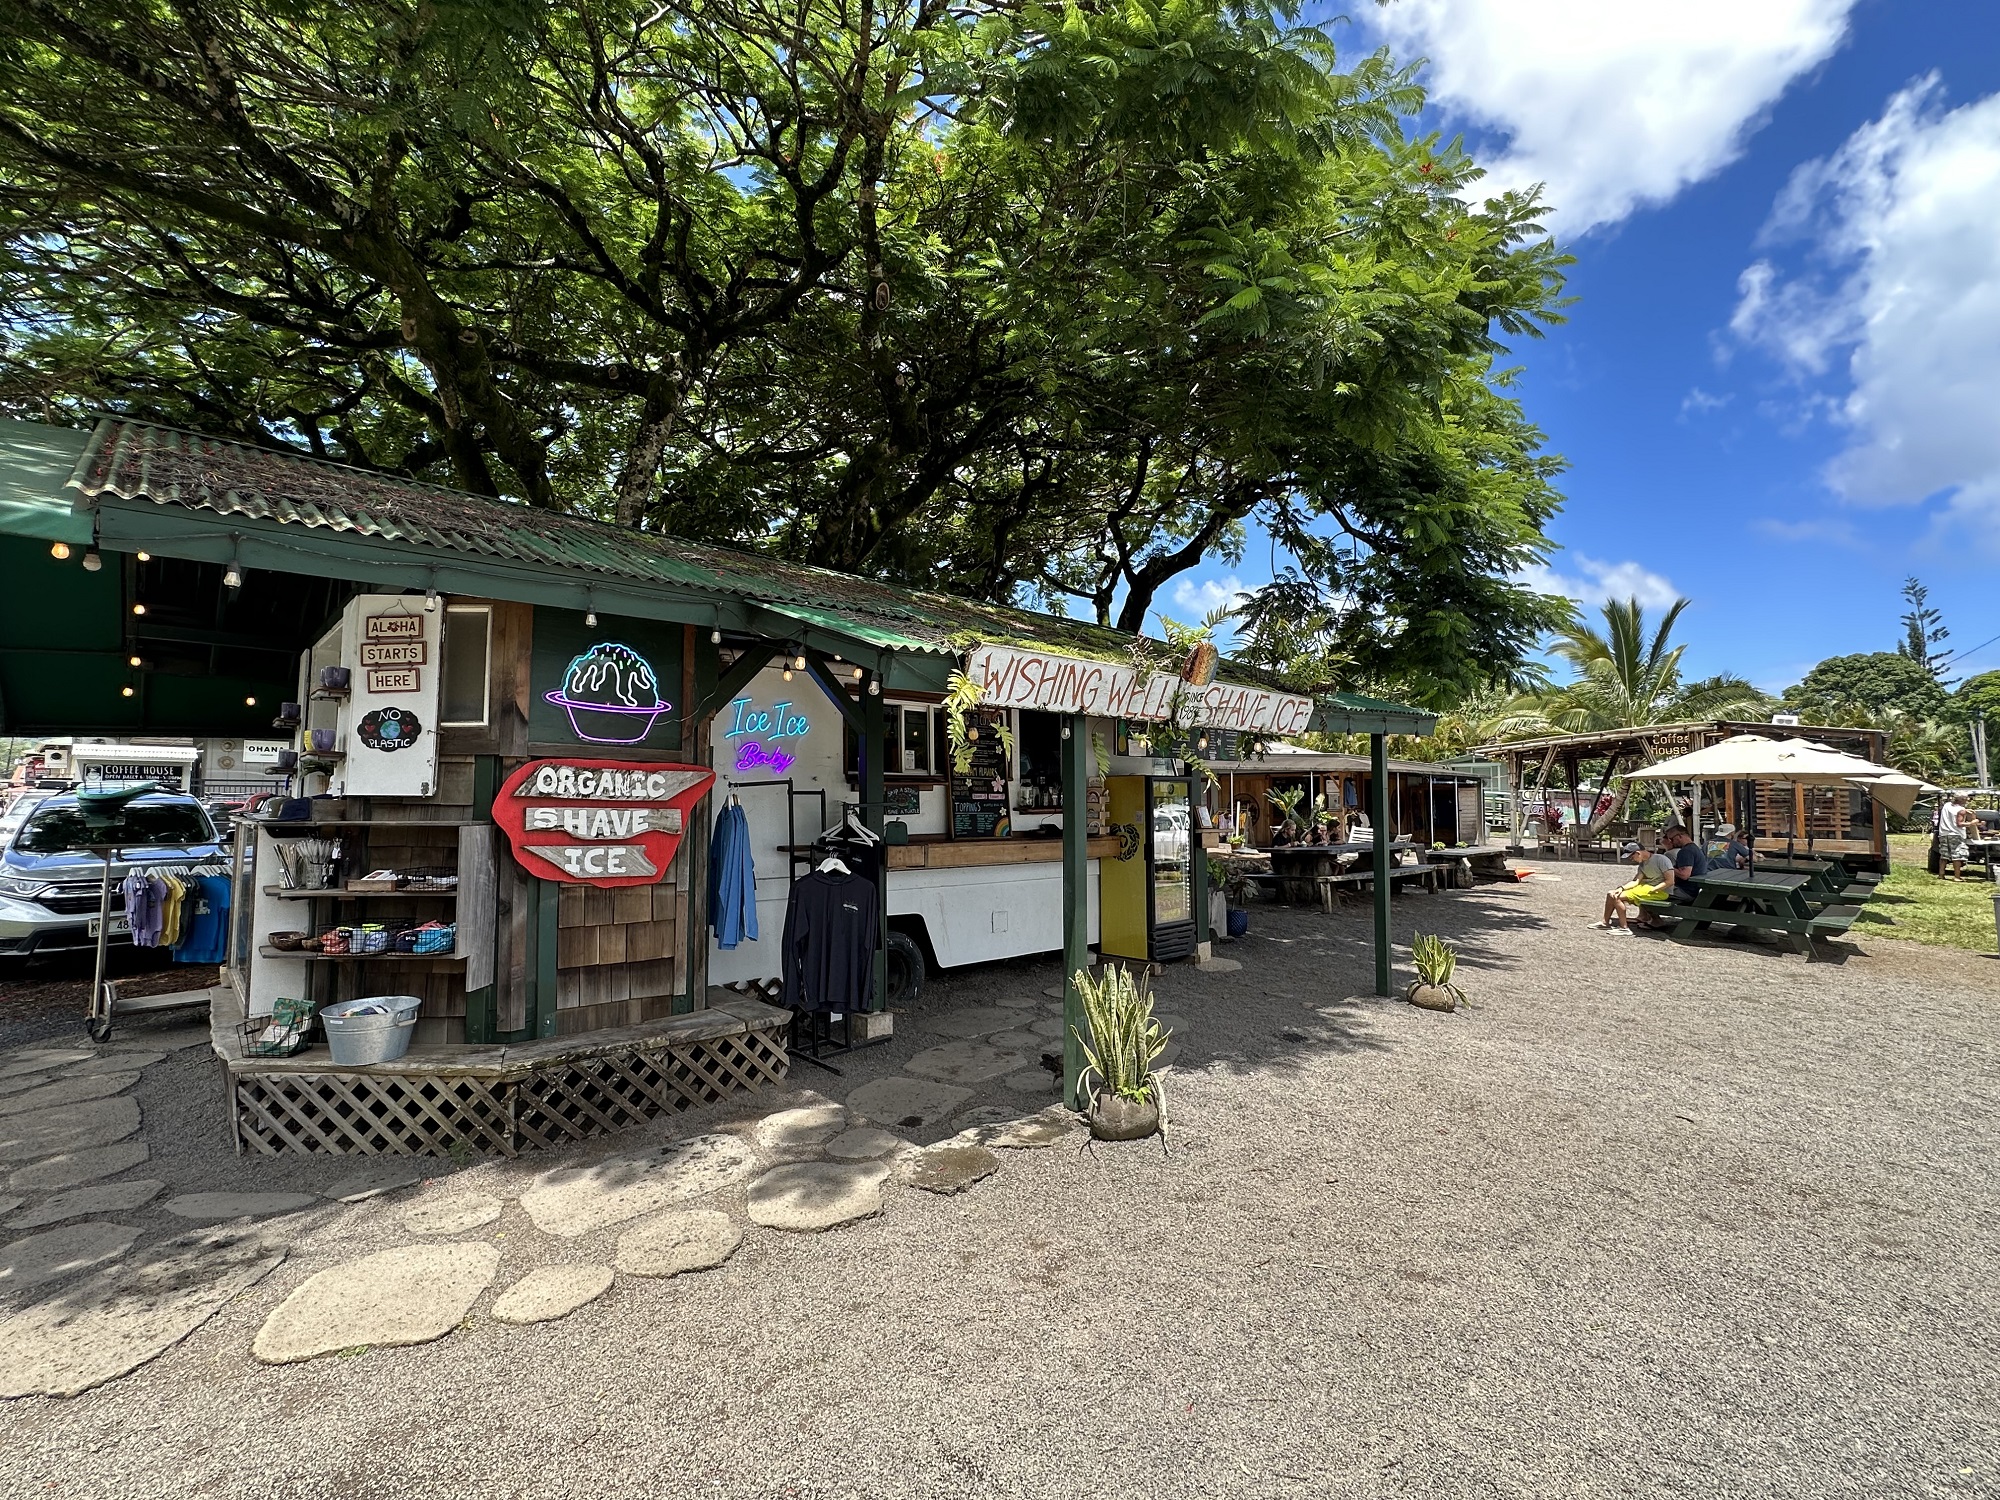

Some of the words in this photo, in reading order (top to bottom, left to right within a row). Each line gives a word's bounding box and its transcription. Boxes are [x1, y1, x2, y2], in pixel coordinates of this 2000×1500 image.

[368, 648, 418, 660] STARTS
[376, 675, 411, 687] HERE
[982, 652, 1103, 712] WISHING
[1106, 671, 1170, 719] WELL
[1186, 691, 1205, 703] SINCE
[379, 710, 401, 721] NO
[1204, 686, 1270, 729] SHAVE
[1270, 697, 1309, 734] ICE
[724, 698, 772, 739] Ice
[767, 702, 810, 741] Ice
[368, 738, 411, 748] PLASTIC
[1652, 733, 1689, 745] Coffee
[1651, 745, 1688, 755] House
[736, 741, 795, 773] Baby
[105, 765, 139, 774] COFFEE
[143, 766, 174, 775] HOUSE
[536, 766, 665, 798] ORGANIC
[954, 802, 982, 812] TOPPINGS
[533, 808, 649, 838] SHAVE
[564, 848, 626, 874] ICE
[117, 920, 129, 930] 48
